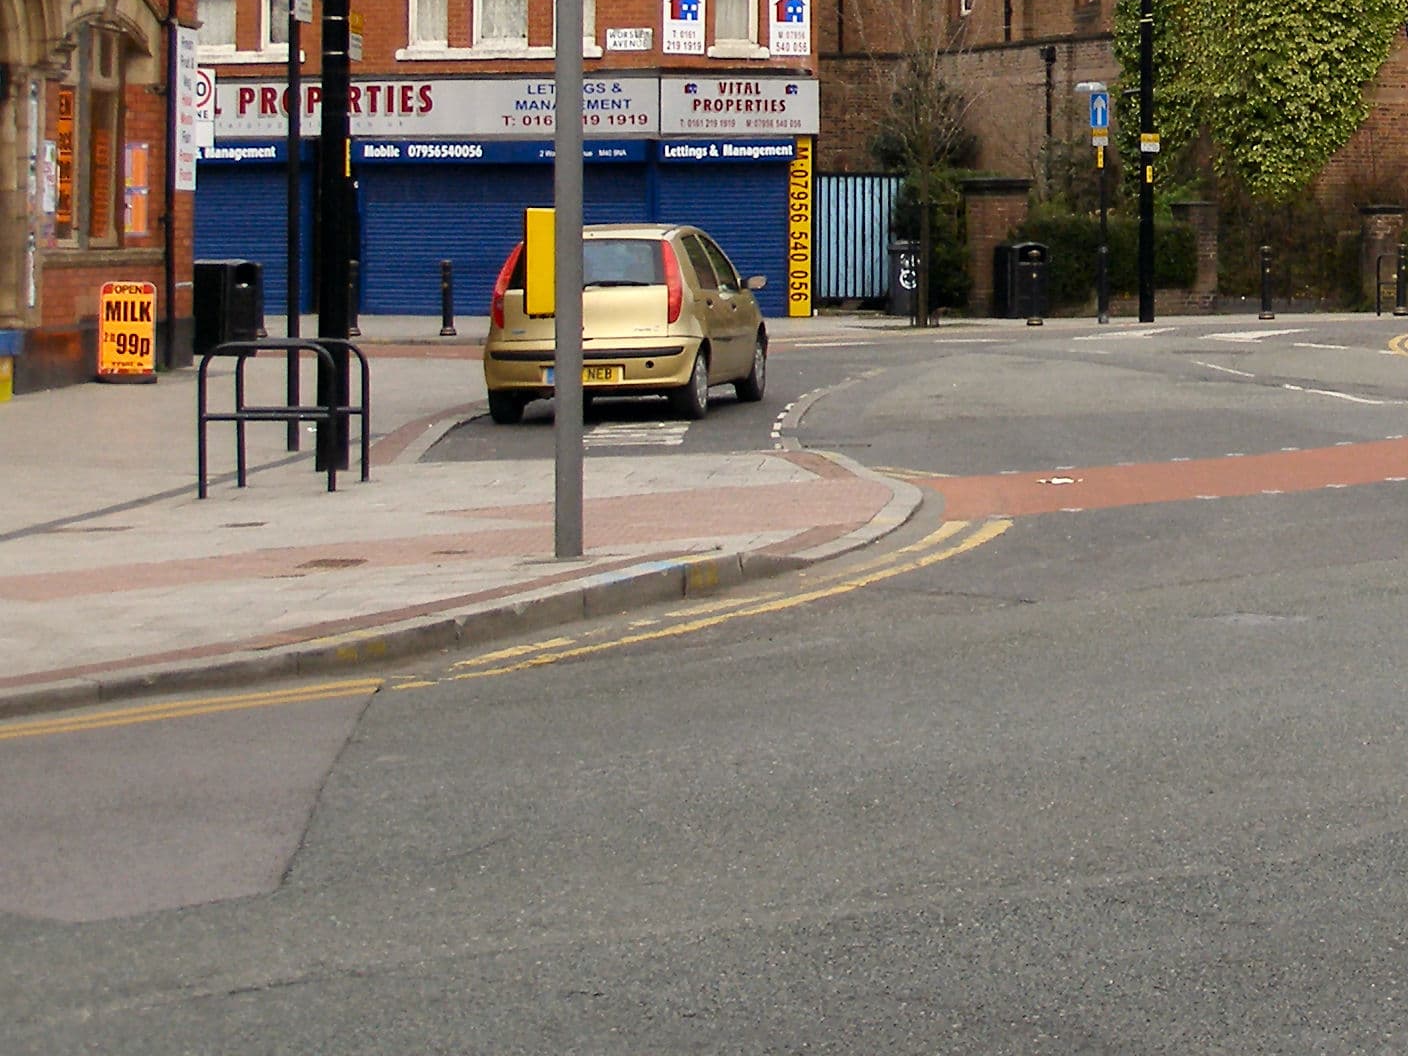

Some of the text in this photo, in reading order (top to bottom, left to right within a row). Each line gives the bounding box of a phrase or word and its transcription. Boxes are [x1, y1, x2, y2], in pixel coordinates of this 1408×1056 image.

[196, 82, 206, 96] 0
[528, 82, 622, 94] LETGS &
[719, 82, 761, 94] VITAL
[239, 85, 433, 114] PRPRTIES
[515, 99, 632, 110] MANMENT
[693, 99, 786, 111] PROPERTIES
[502, 114, 648, 126] T: 016 19 1919
[364, 145, 482, 157] Mobile 07956540056
[664, 144, 793, 159] Lettings & Management
[791, 231, 808, 262] 540
[114, 284, 142, 294] OPEN
[791, 270, 808, 302] 056
[106, 300, 151, 322] MILK
[116, 333, 150, 357] 99p
[588, 367, 612, 380] NEB
